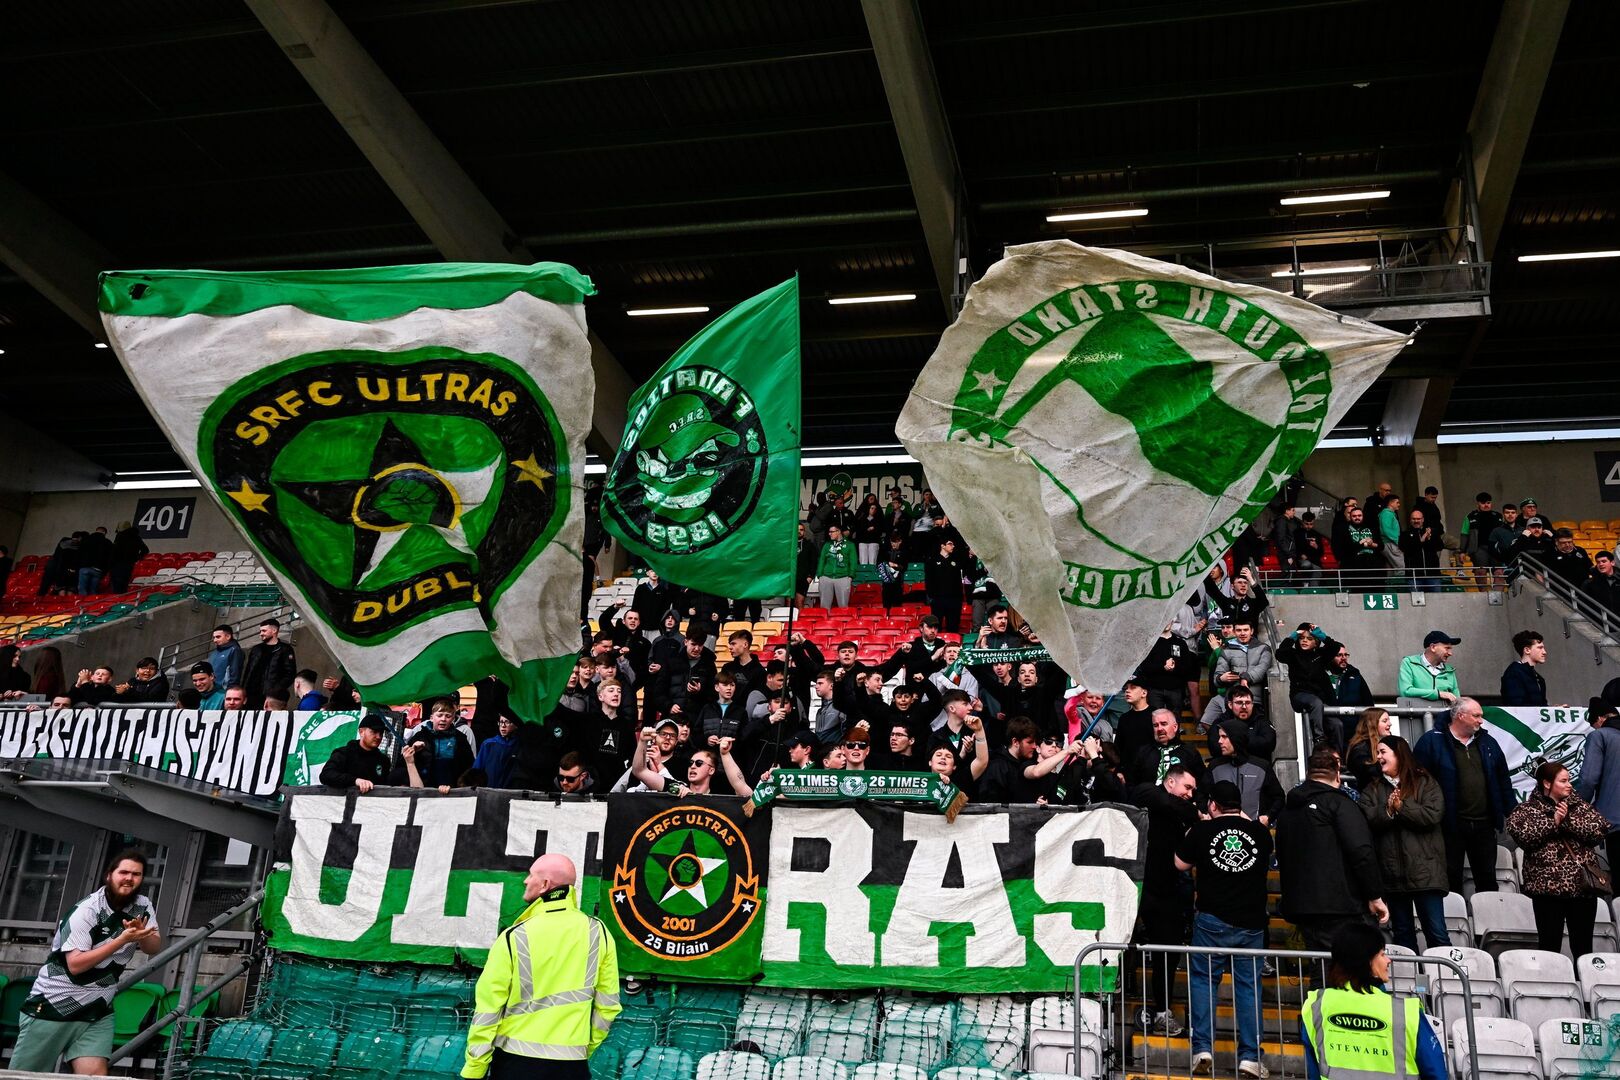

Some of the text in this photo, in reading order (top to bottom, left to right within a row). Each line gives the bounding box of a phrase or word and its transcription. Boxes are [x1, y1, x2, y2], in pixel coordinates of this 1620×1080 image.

[235, 373, 517, 446] SRFC ULTRAS
[139, 505, 189, 531] 401
[982, 656, 1022, 664] FOOTBALL
[299, 719, 320, 740] THE
[174, 709, 289, 795] STAND
[779, 774, 838, 787] 22 TIMES
[869, 776, 928, 788] 26 TIMES
[645, 814, 737, 847] SRFC ULTRAS
[1210, 829, 1256, 847] LOVE ROVERS
[1211, 856, 1257, 873] HATE RACISM
[661, 917, 696, 932] 2001
[644, 934, 709, 955] 25 Bliain
[1335, 1015, 1378, 1029] SWORD
[1329, 1043, 1389, 1056] STEWARD
